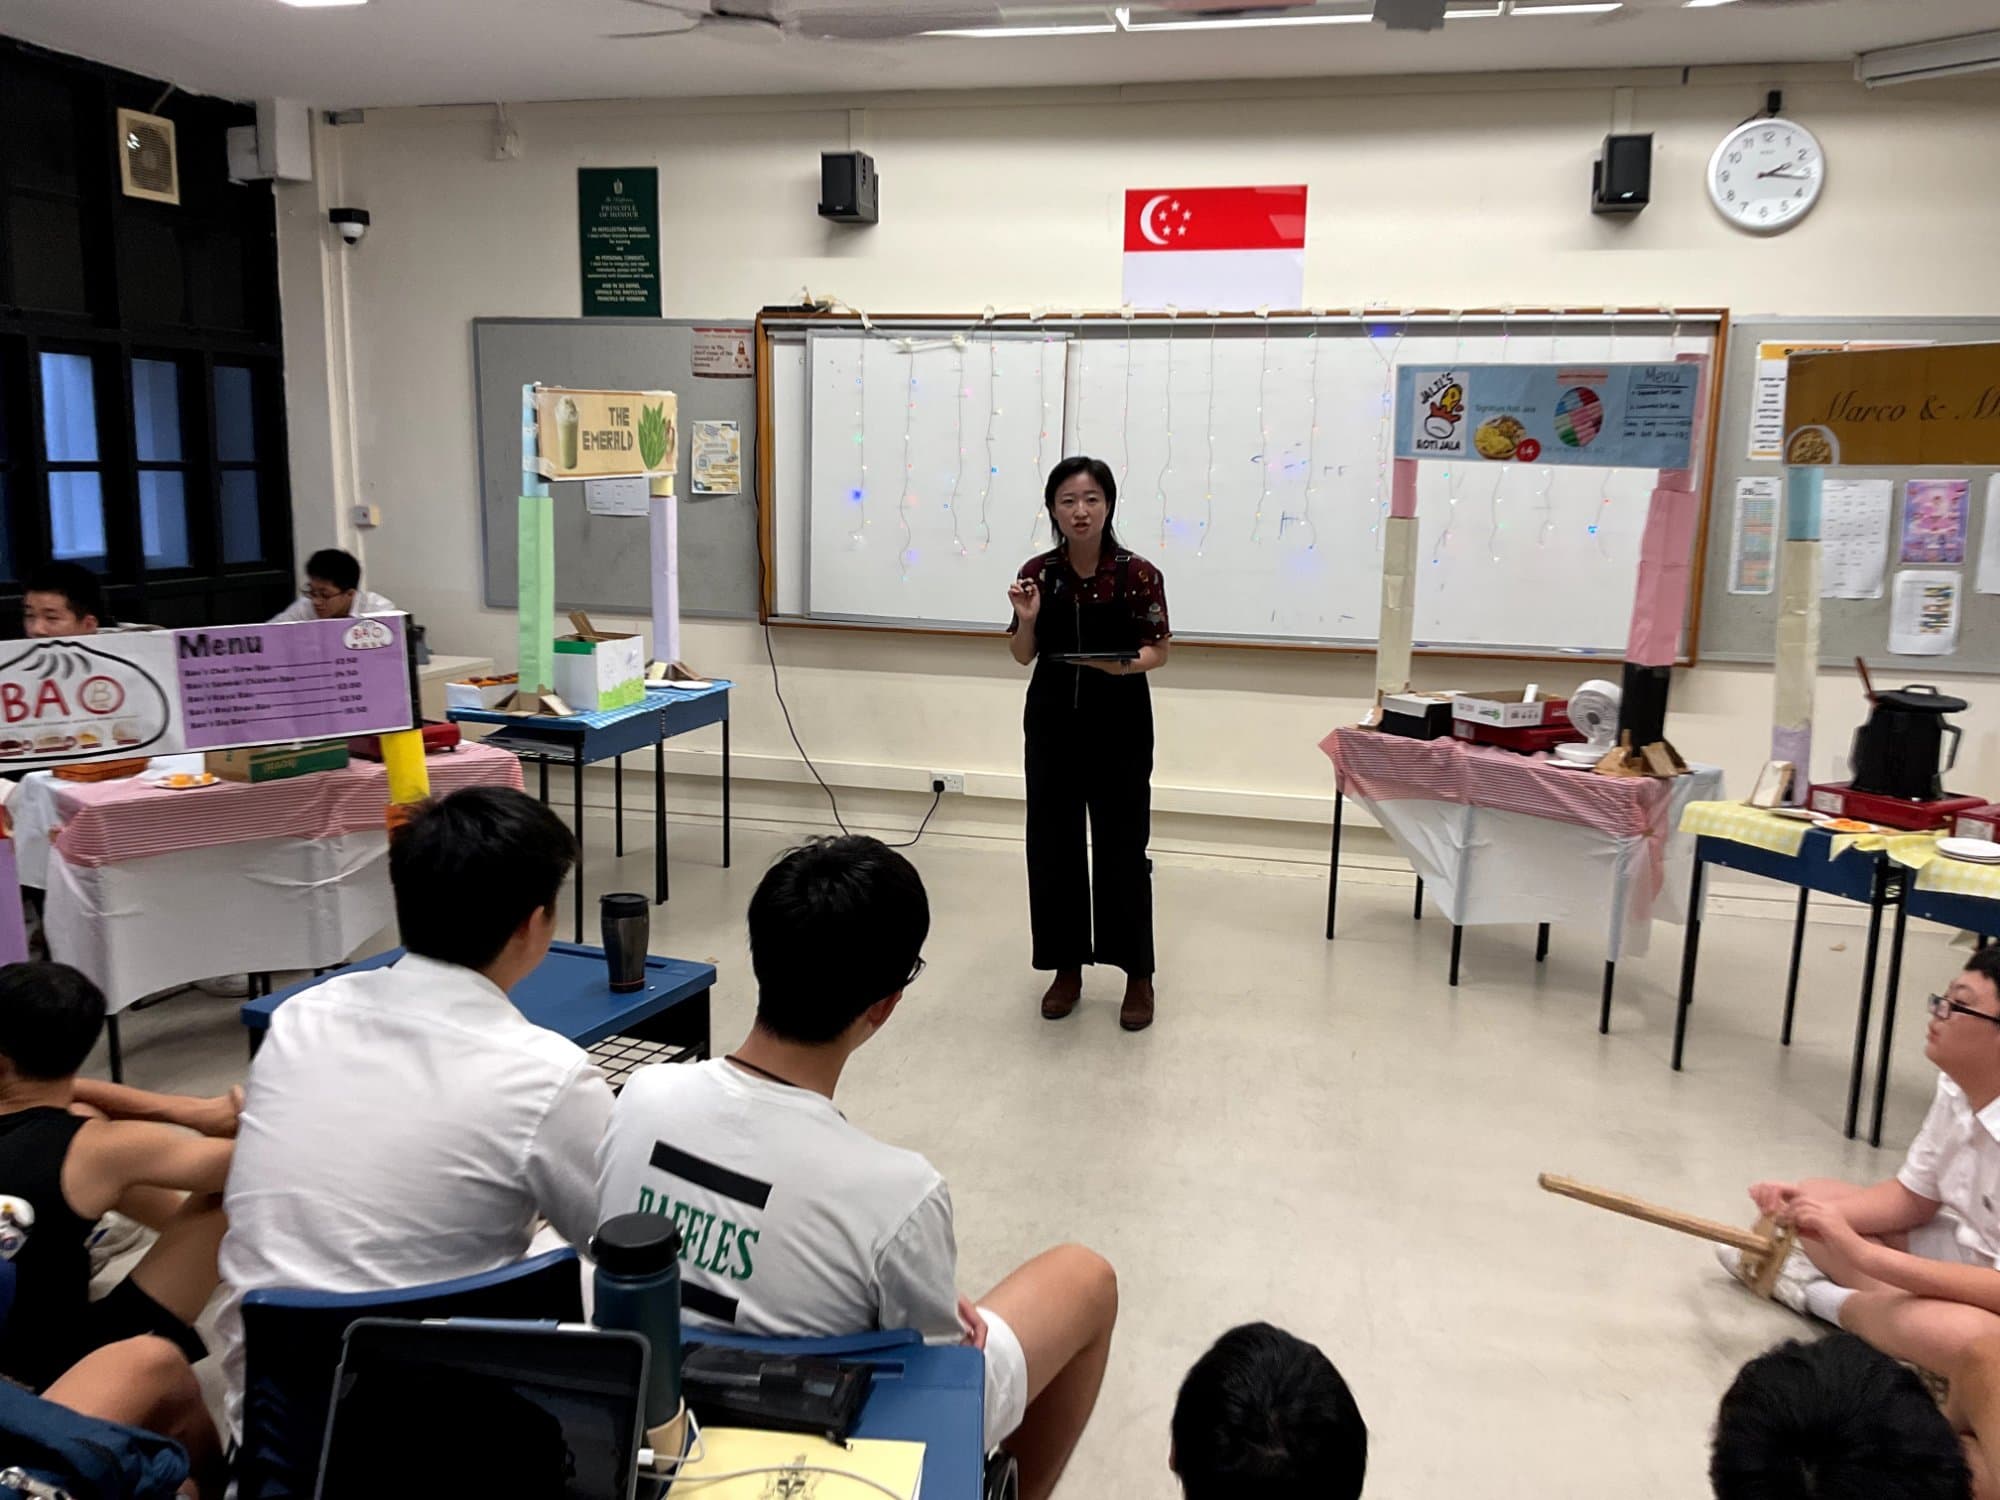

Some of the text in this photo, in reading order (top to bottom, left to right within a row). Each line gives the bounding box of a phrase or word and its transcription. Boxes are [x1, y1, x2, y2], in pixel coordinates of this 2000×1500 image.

[1762, 130, 1776, 143] 12
[1784, 135, 1792, 147] 1
[1743, 137, 1754, 149] 11
[1728, 151, 1742, 164] 10
[1798, 148, 1808, 160] 2
[1721, 169, 1730, 182] 9
[1727, 189, 1735, 201] 8
[1794, 187, 1803, 198] 4
[1740, 201, 1749, 213] 7
[1760, 206, 1768, 218] 6
[1780, 200, 1789, 212] 5
[1644, 366, 1680, 384] Menu
[1822, 389, 1906, 423] Marco
[1919, 394, 1947, 421] &
[608, 407, 630, 426] THE
[582, 430, 634, 451] EMERALD
[1416, 439, 1461, 451] ROTI JALA
[178, 633, 263, 659] Menu
[0, 675, 126, 723] BAO
